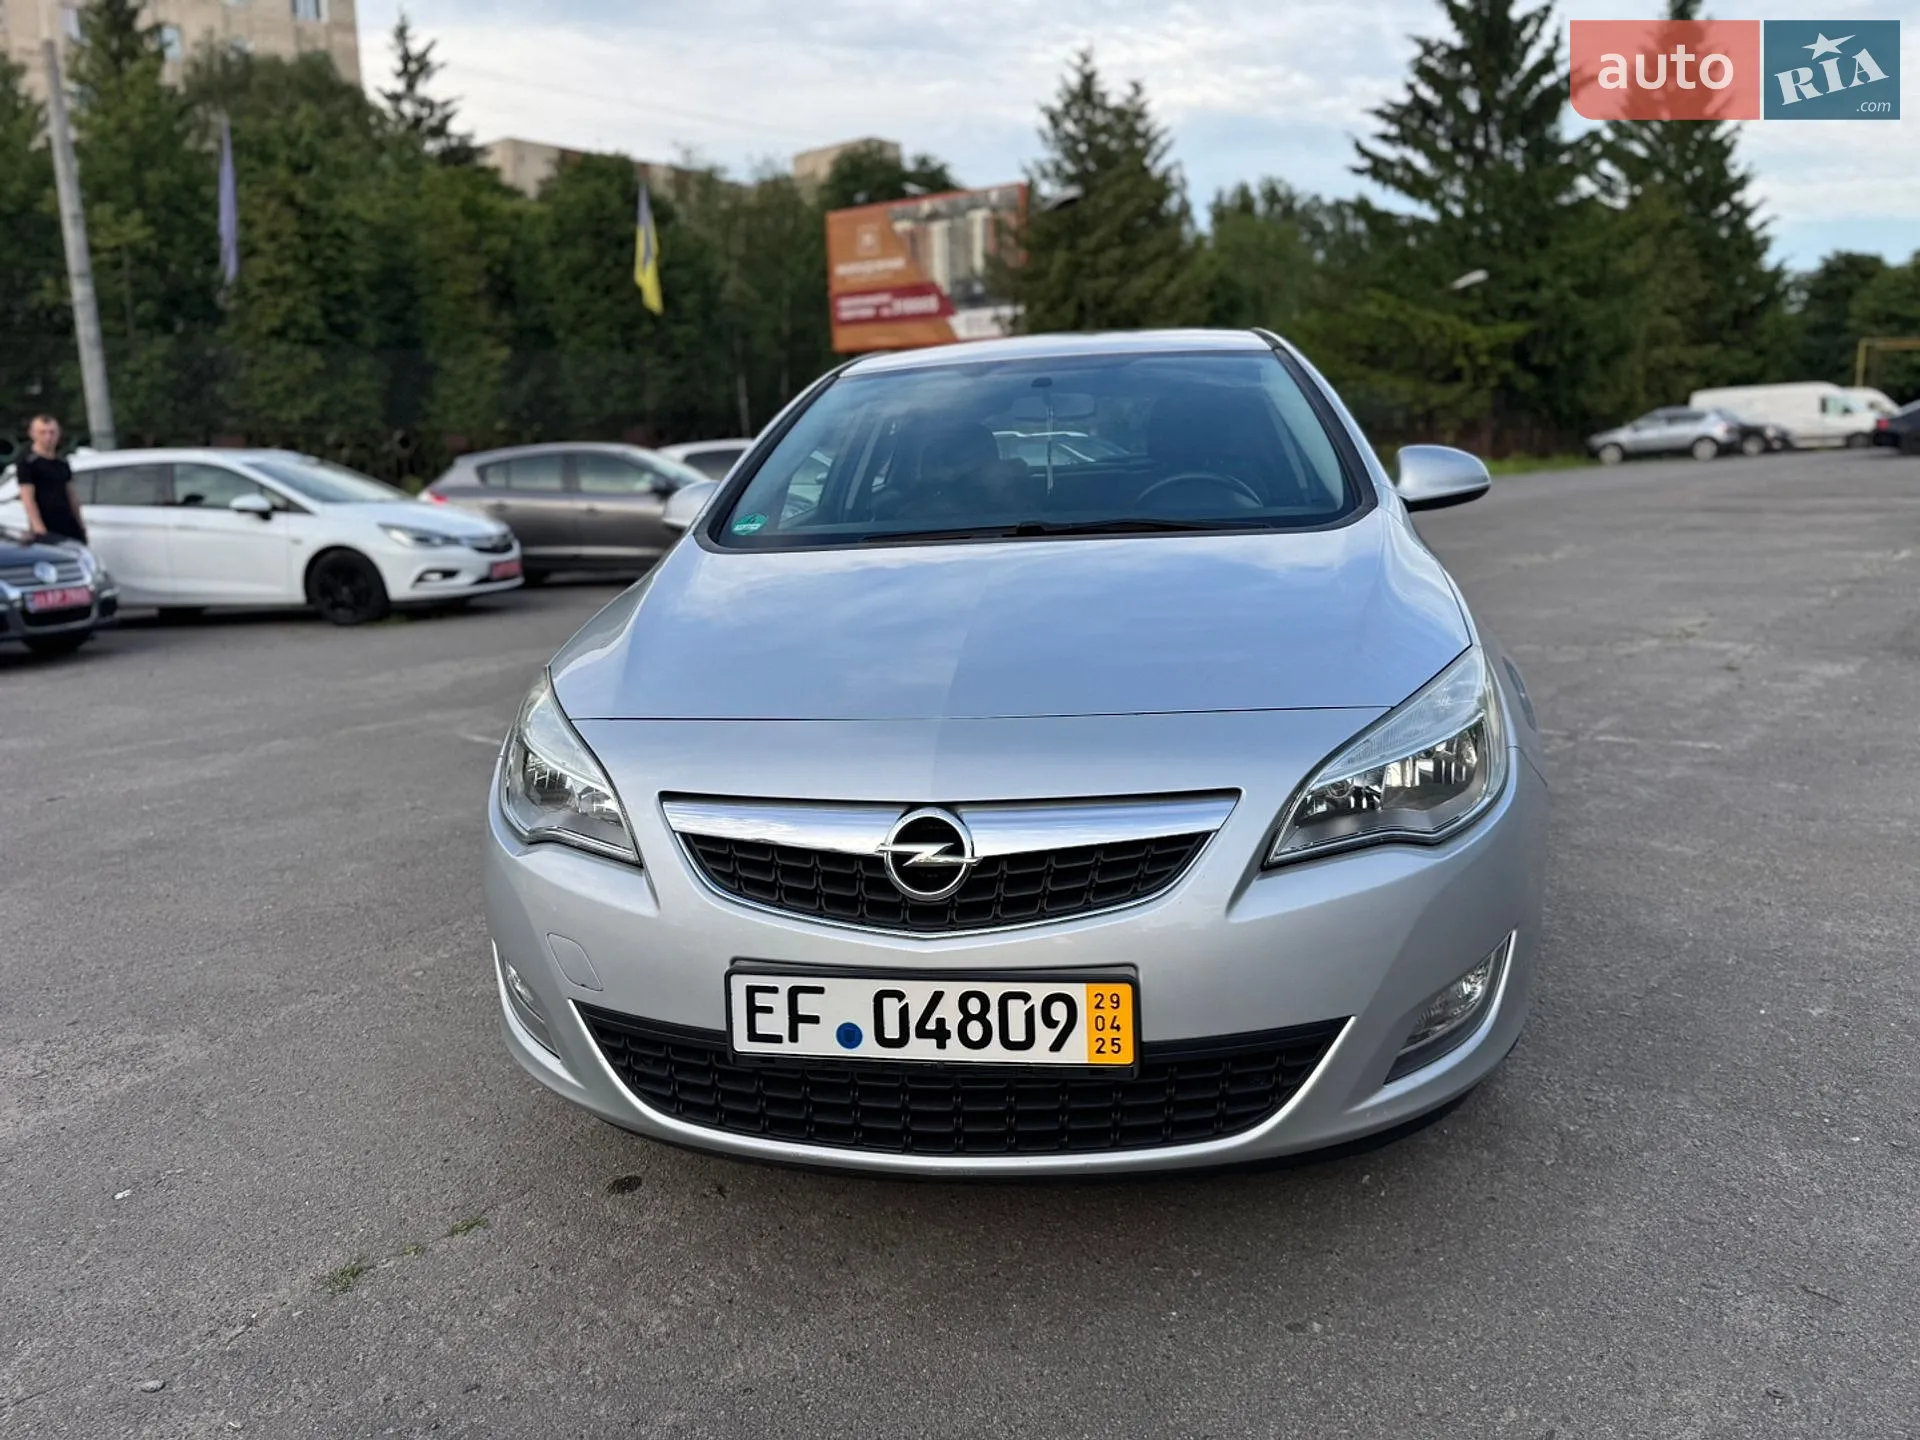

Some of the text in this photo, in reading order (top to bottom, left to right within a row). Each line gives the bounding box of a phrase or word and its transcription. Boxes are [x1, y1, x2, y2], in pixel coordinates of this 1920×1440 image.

[1094, 992, 1121, 1010] 29
[745, 984, 1079, 1052] EF 04809
[1094, 1015, 1121, 1032] 04
[1095, 1037, 1122, 1054] 25
